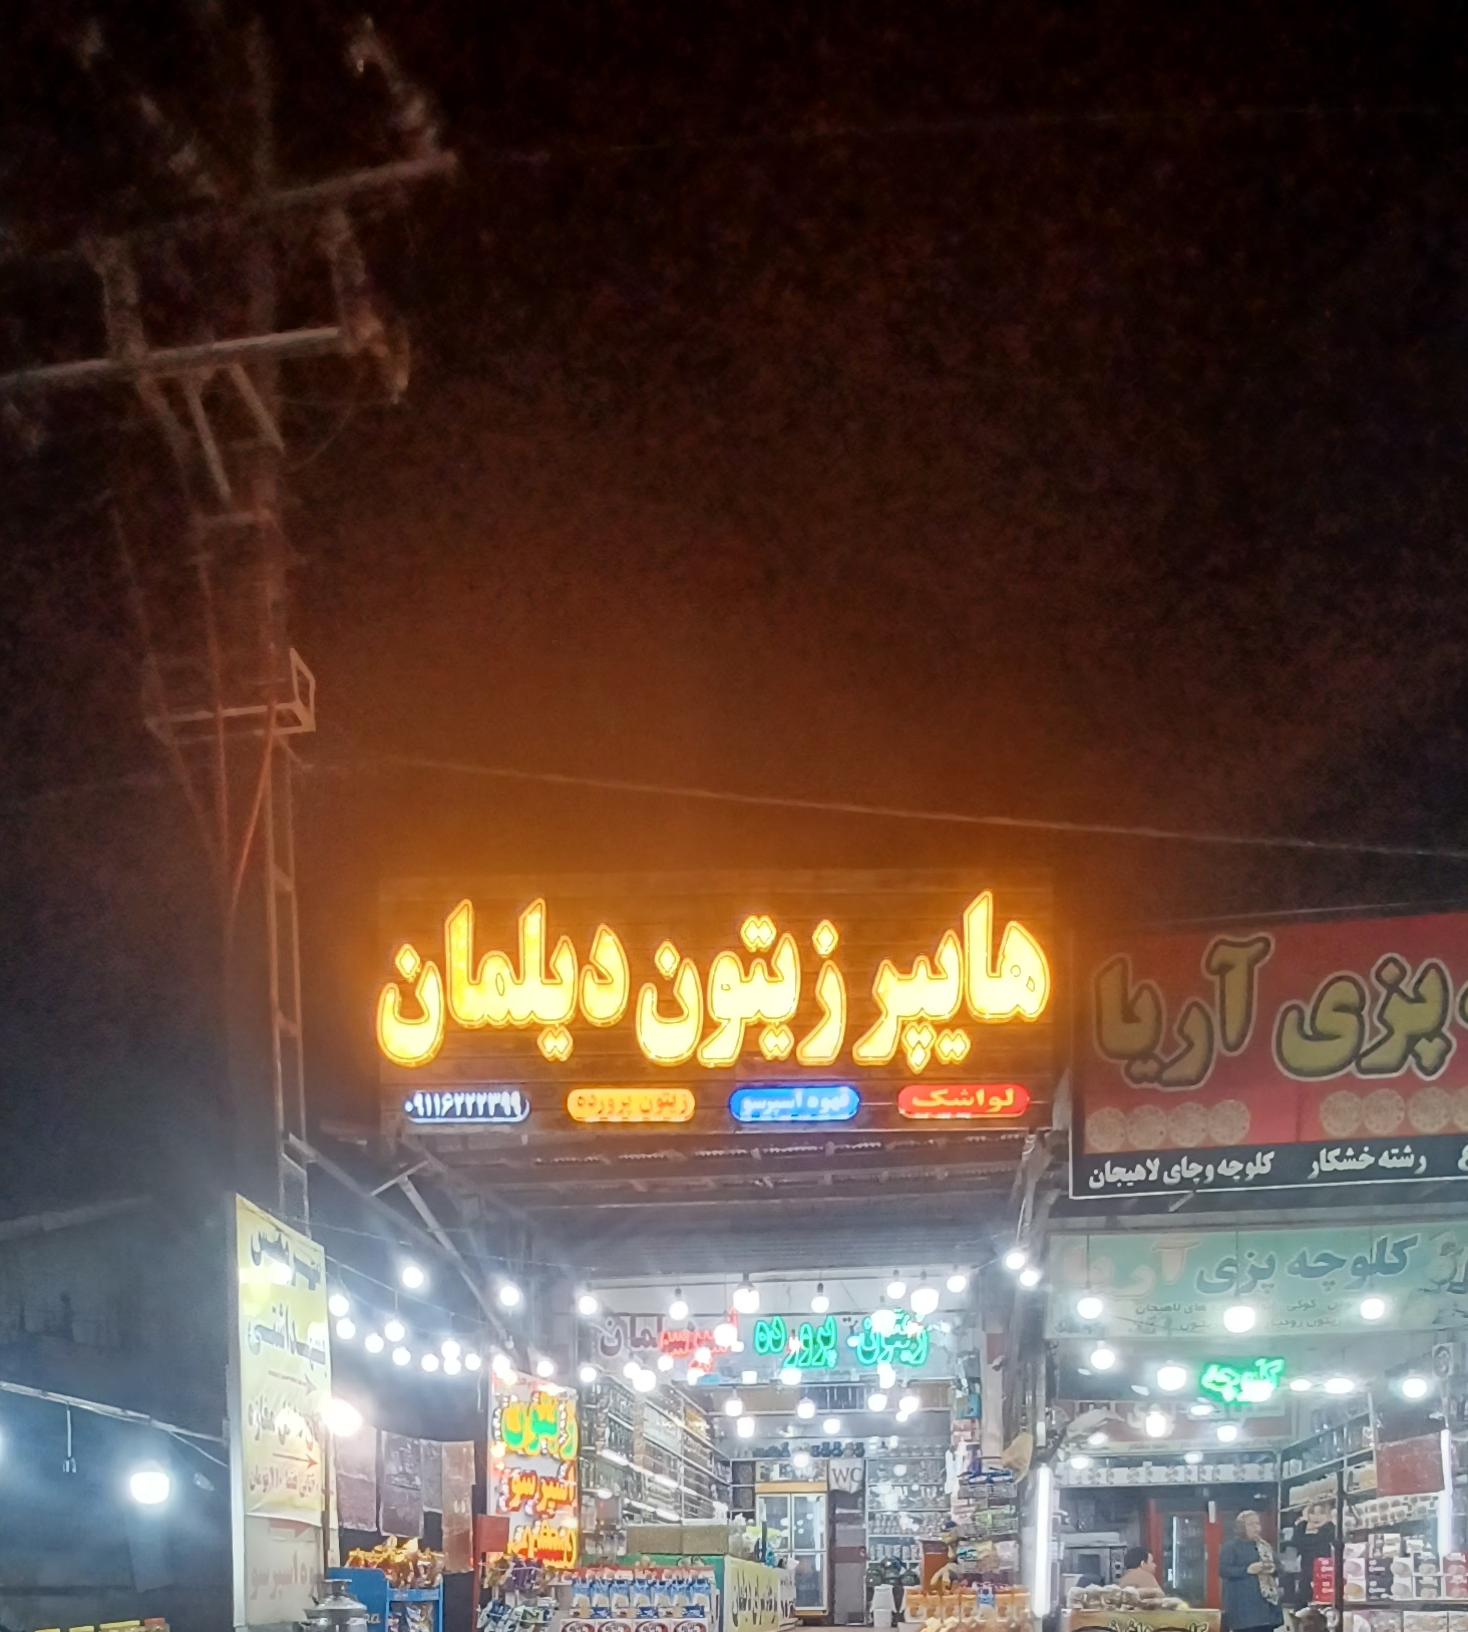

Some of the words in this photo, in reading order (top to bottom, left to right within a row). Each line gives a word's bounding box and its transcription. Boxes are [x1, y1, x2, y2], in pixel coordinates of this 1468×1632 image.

[377, 898, 630, 1067] دیلمان
[635, 914, 846, 1066] زیتون
[852, 889, 1050, 1075] هایپر
[1093, 931, 1275, 1092] آریا
[1272, 952, 1457, 1082] پزی
[911, 1088, 1015, 1113] لواشک
[1088, 1157, 1161, 1189] لاهیجان
[1217, 1150, 1276, 1183] کلوچه
[1307, 1145, 1376, 1180] خشکار
[1378, 1144, 1427, 1175] رشته
[1195, 1249, 1277, 1297] پزی
[1286, 1231, 1422, 1293] کلوچه
[831, 1467, 863, 1484] WC
